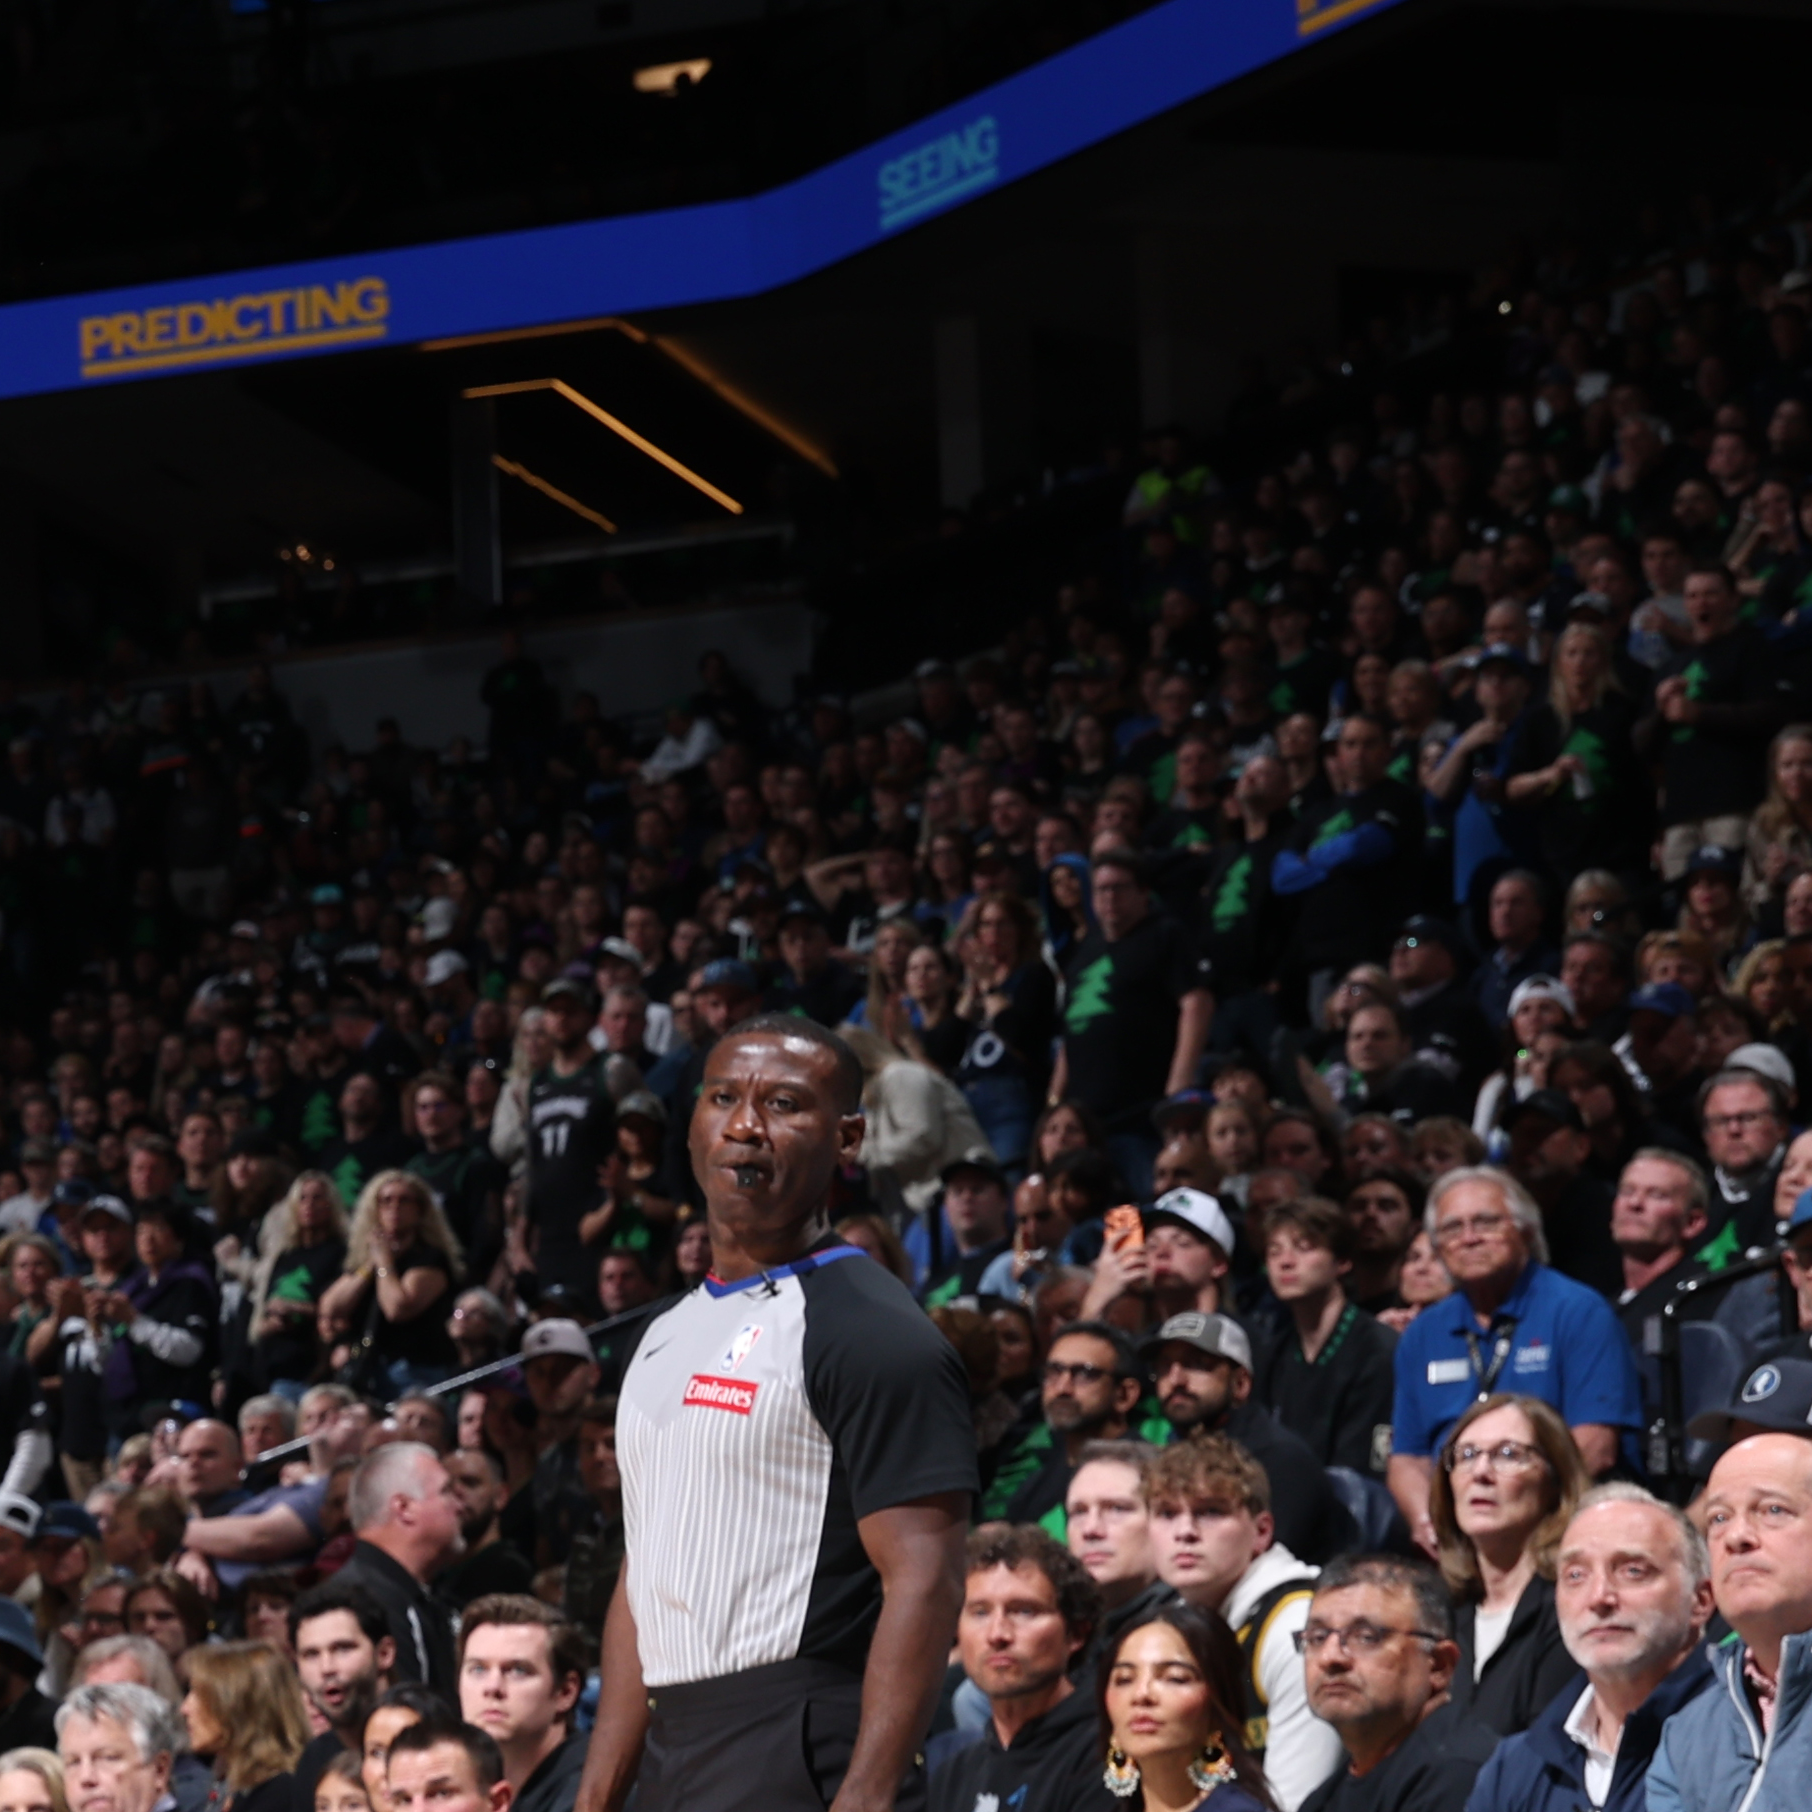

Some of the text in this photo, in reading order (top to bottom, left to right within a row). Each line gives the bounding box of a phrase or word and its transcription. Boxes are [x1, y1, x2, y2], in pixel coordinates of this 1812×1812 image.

[879, 115, 999, 202] SEEING
[80, 277, 389, 359] PREDICTING
[685, 1378, 753, 1408] Emirates
